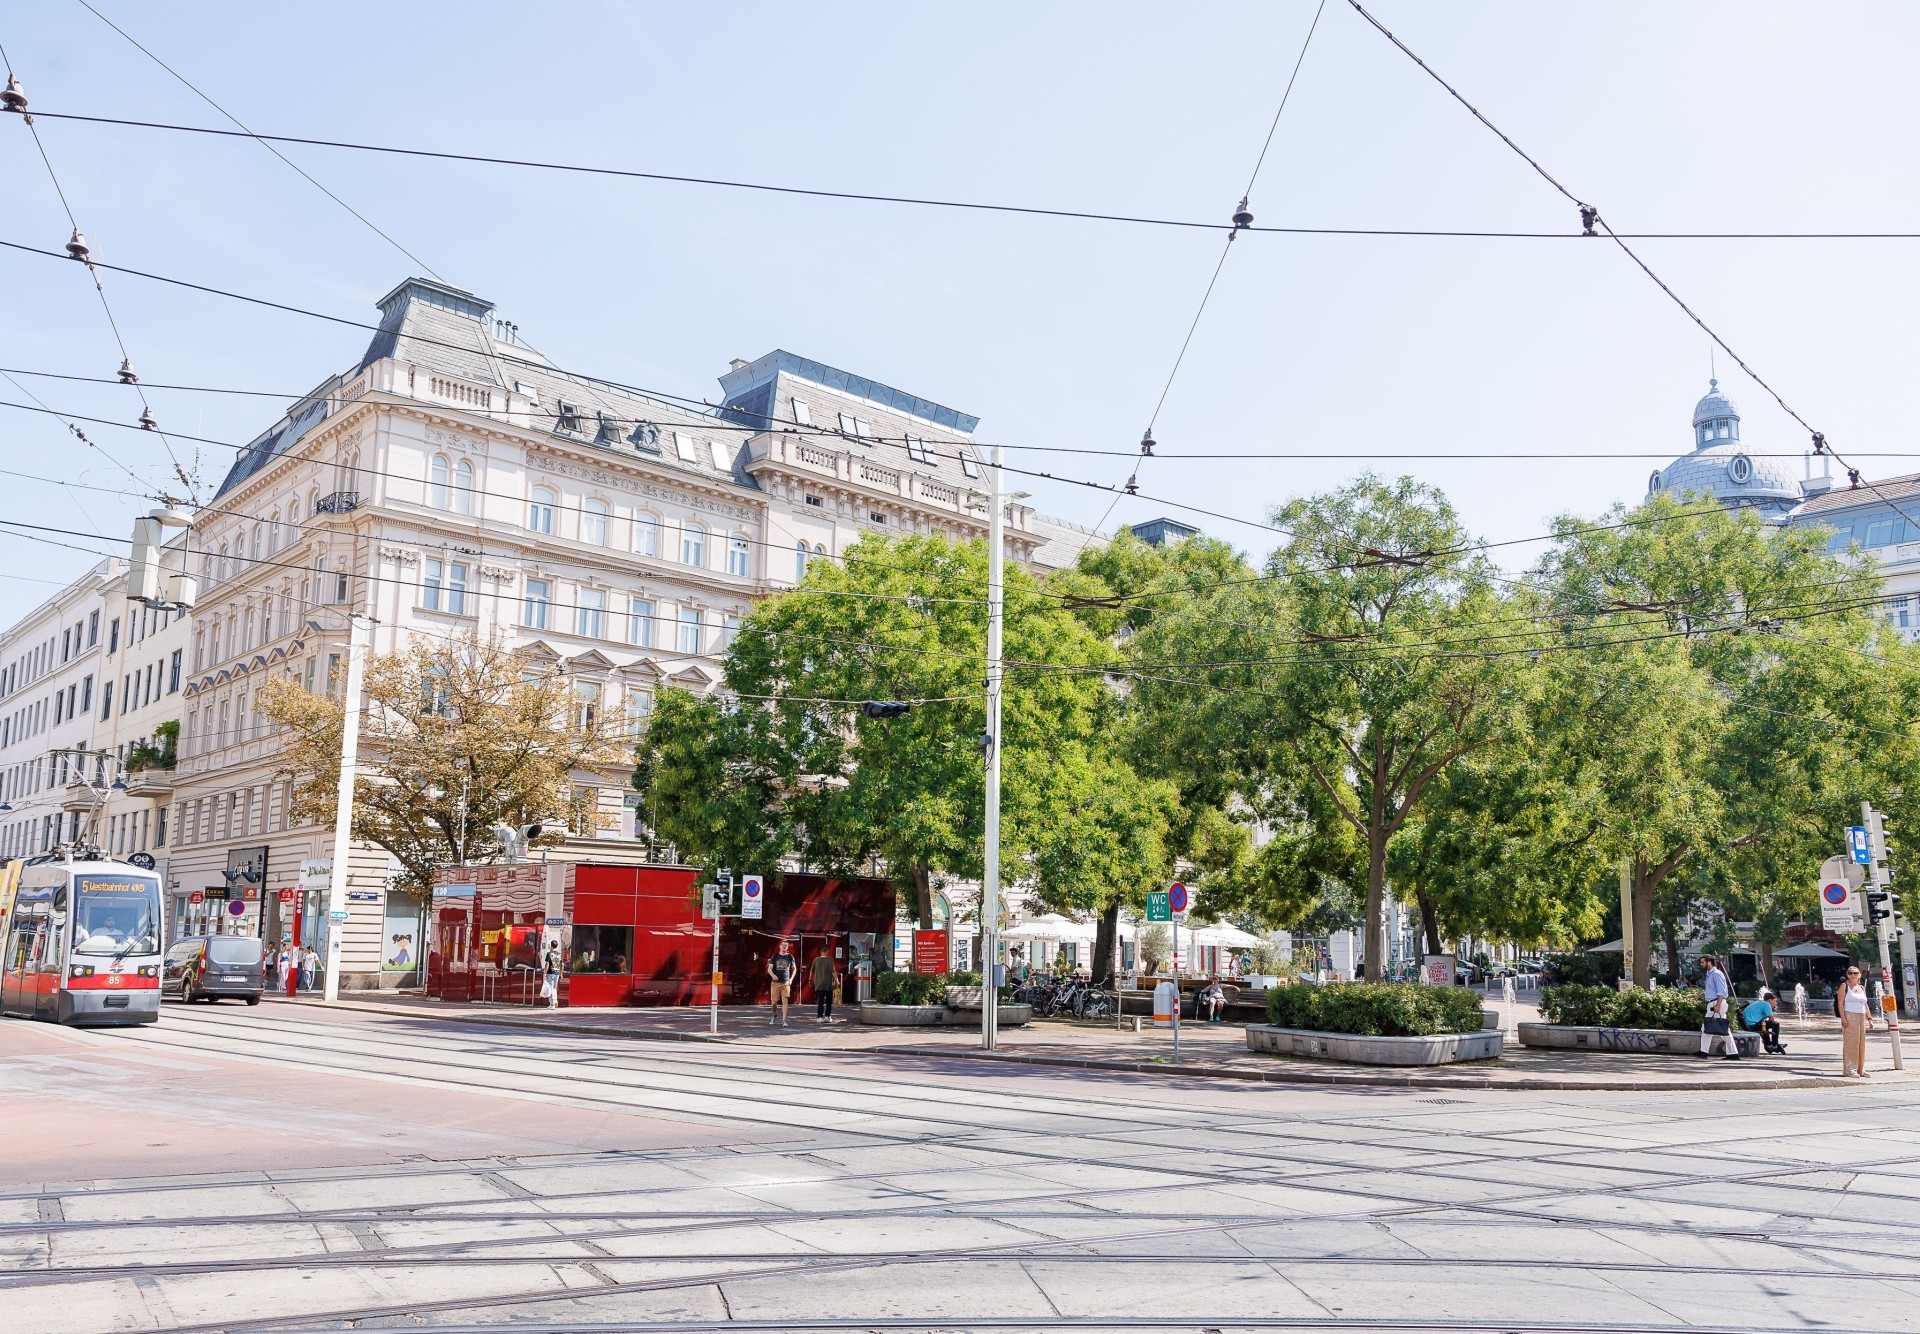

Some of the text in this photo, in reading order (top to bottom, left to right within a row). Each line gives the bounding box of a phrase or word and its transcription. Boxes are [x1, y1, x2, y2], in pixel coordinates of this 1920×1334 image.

[83, 880, 90, 893] 5
[90, 882, 130, 892] Westbahnhof
[1151, 894, 1167, 905] WC
[109, 976, 120, 985] 85
